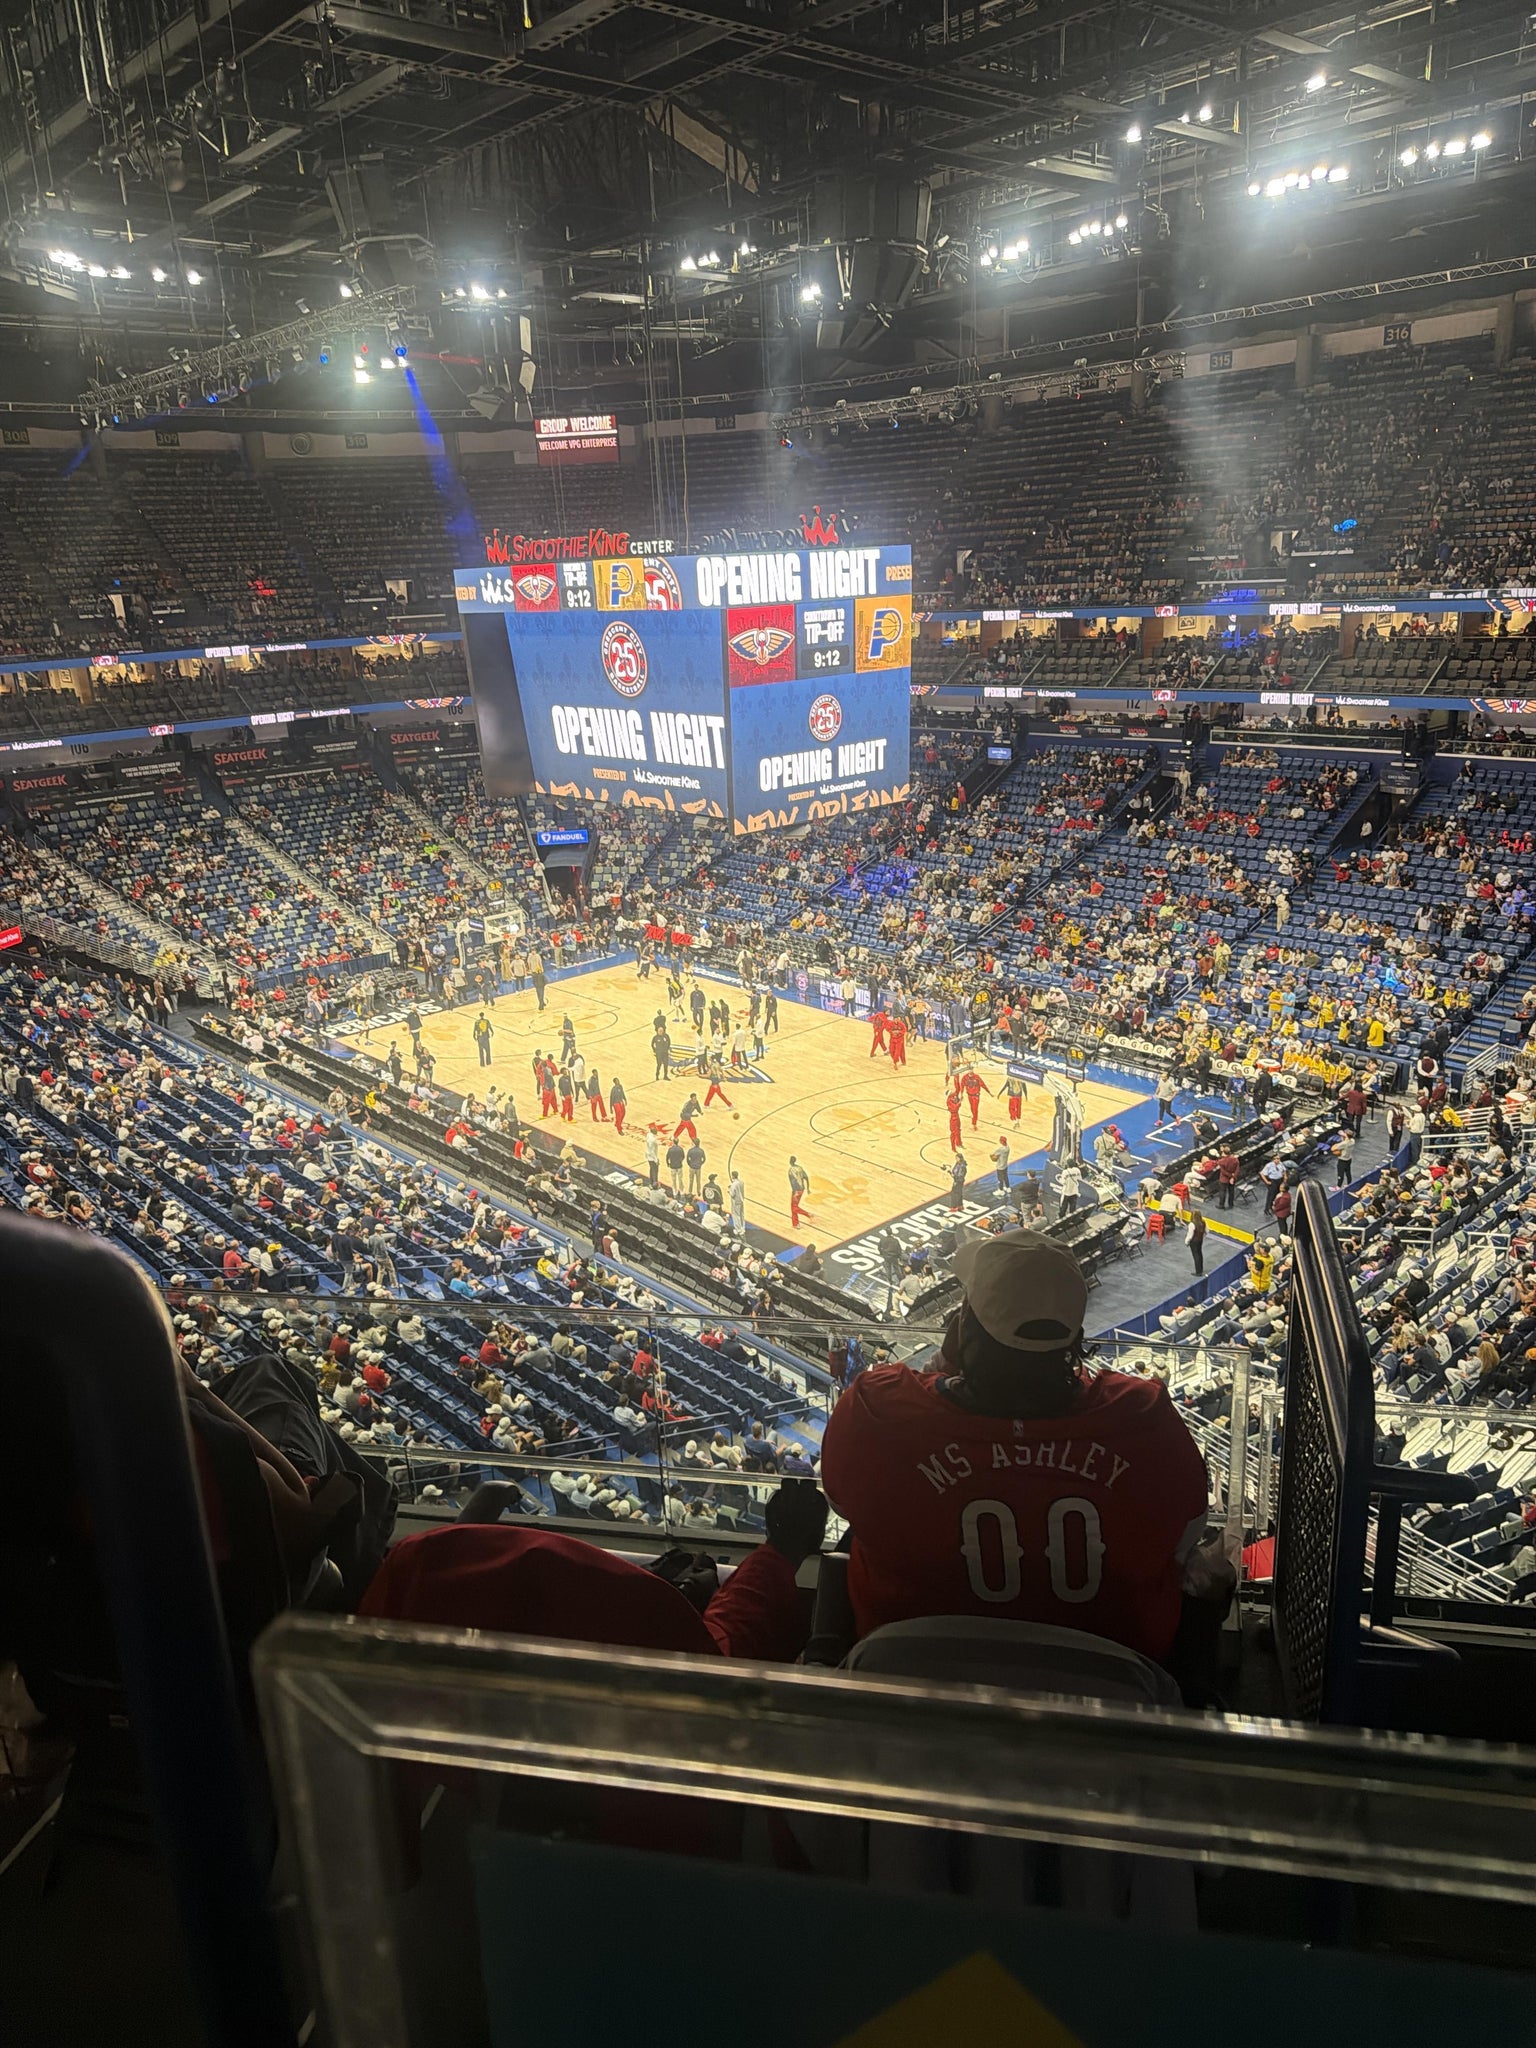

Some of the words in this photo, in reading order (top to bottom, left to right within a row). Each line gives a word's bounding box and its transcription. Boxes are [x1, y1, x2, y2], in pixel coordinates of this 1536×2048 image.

[1386, 326, 1409, 341] 316
[1211, 354, 1231, 367] 315
[540, 418, 568, 434] GROUP
[570, 415, 612, 432] WELCOME
[4, 430, 28, 443] 308
[157, 432, 179, 446] 309
[539, 439, 569, 451] WELCOME
[569, 439, 582, 449] VPG
[581, 437, 617, 449] ENTERPRISE
[512, 535, 588, 563] SMOOTHIE
[630, 539, 675, 556] CENTER
[697, 552, 802, 608] OPENING
[809, 549, 881, 600] NIGHT
[566, 589, 592, 608] 9:12
[1269, 603, 1299, 616] OPENING
[1300, 603, 1322, 615] NIGHT
[804, 621, 845, 644] TIP-OFF
[611, 641, 638, 678] 25
[814, 650, 841, 668] 9:12
[1126, 699, 1141, 709] 112
[1261, 693, 1290, 705] OPENING
[1292, 693, 1314, 705] NIGHT
[447, 704, 464, 716] 108
[817, 706, 835, 730] 25
[390, 730, 441, 745] SEATGEEK
[551, 705, 648, 761] OPENING
[650, 711, 726, 769] NIGHT
[214, 748, 268, 765] SEATGEEK
[760, 747, 833, 792] OPENING
[838, 738, 887, 777] NIGHT
[13, 774, 68, 792] SEATGEEK
[552, 833, 585, 842] FANDUEL
[1131, 1040, 1138, 1048] G
[1143, 1043, 1150, 1051] G
[1156, 1046, 1163, 1054] G
[1216, 1061, 1223, 1069] G
[1285, 1077, 1292, 1085] G
[917, 1442, 973, 1495] MS
[991, 1439, 1131, 1490] ASHLEY
[960, 1497, 1106, 1603] 00
